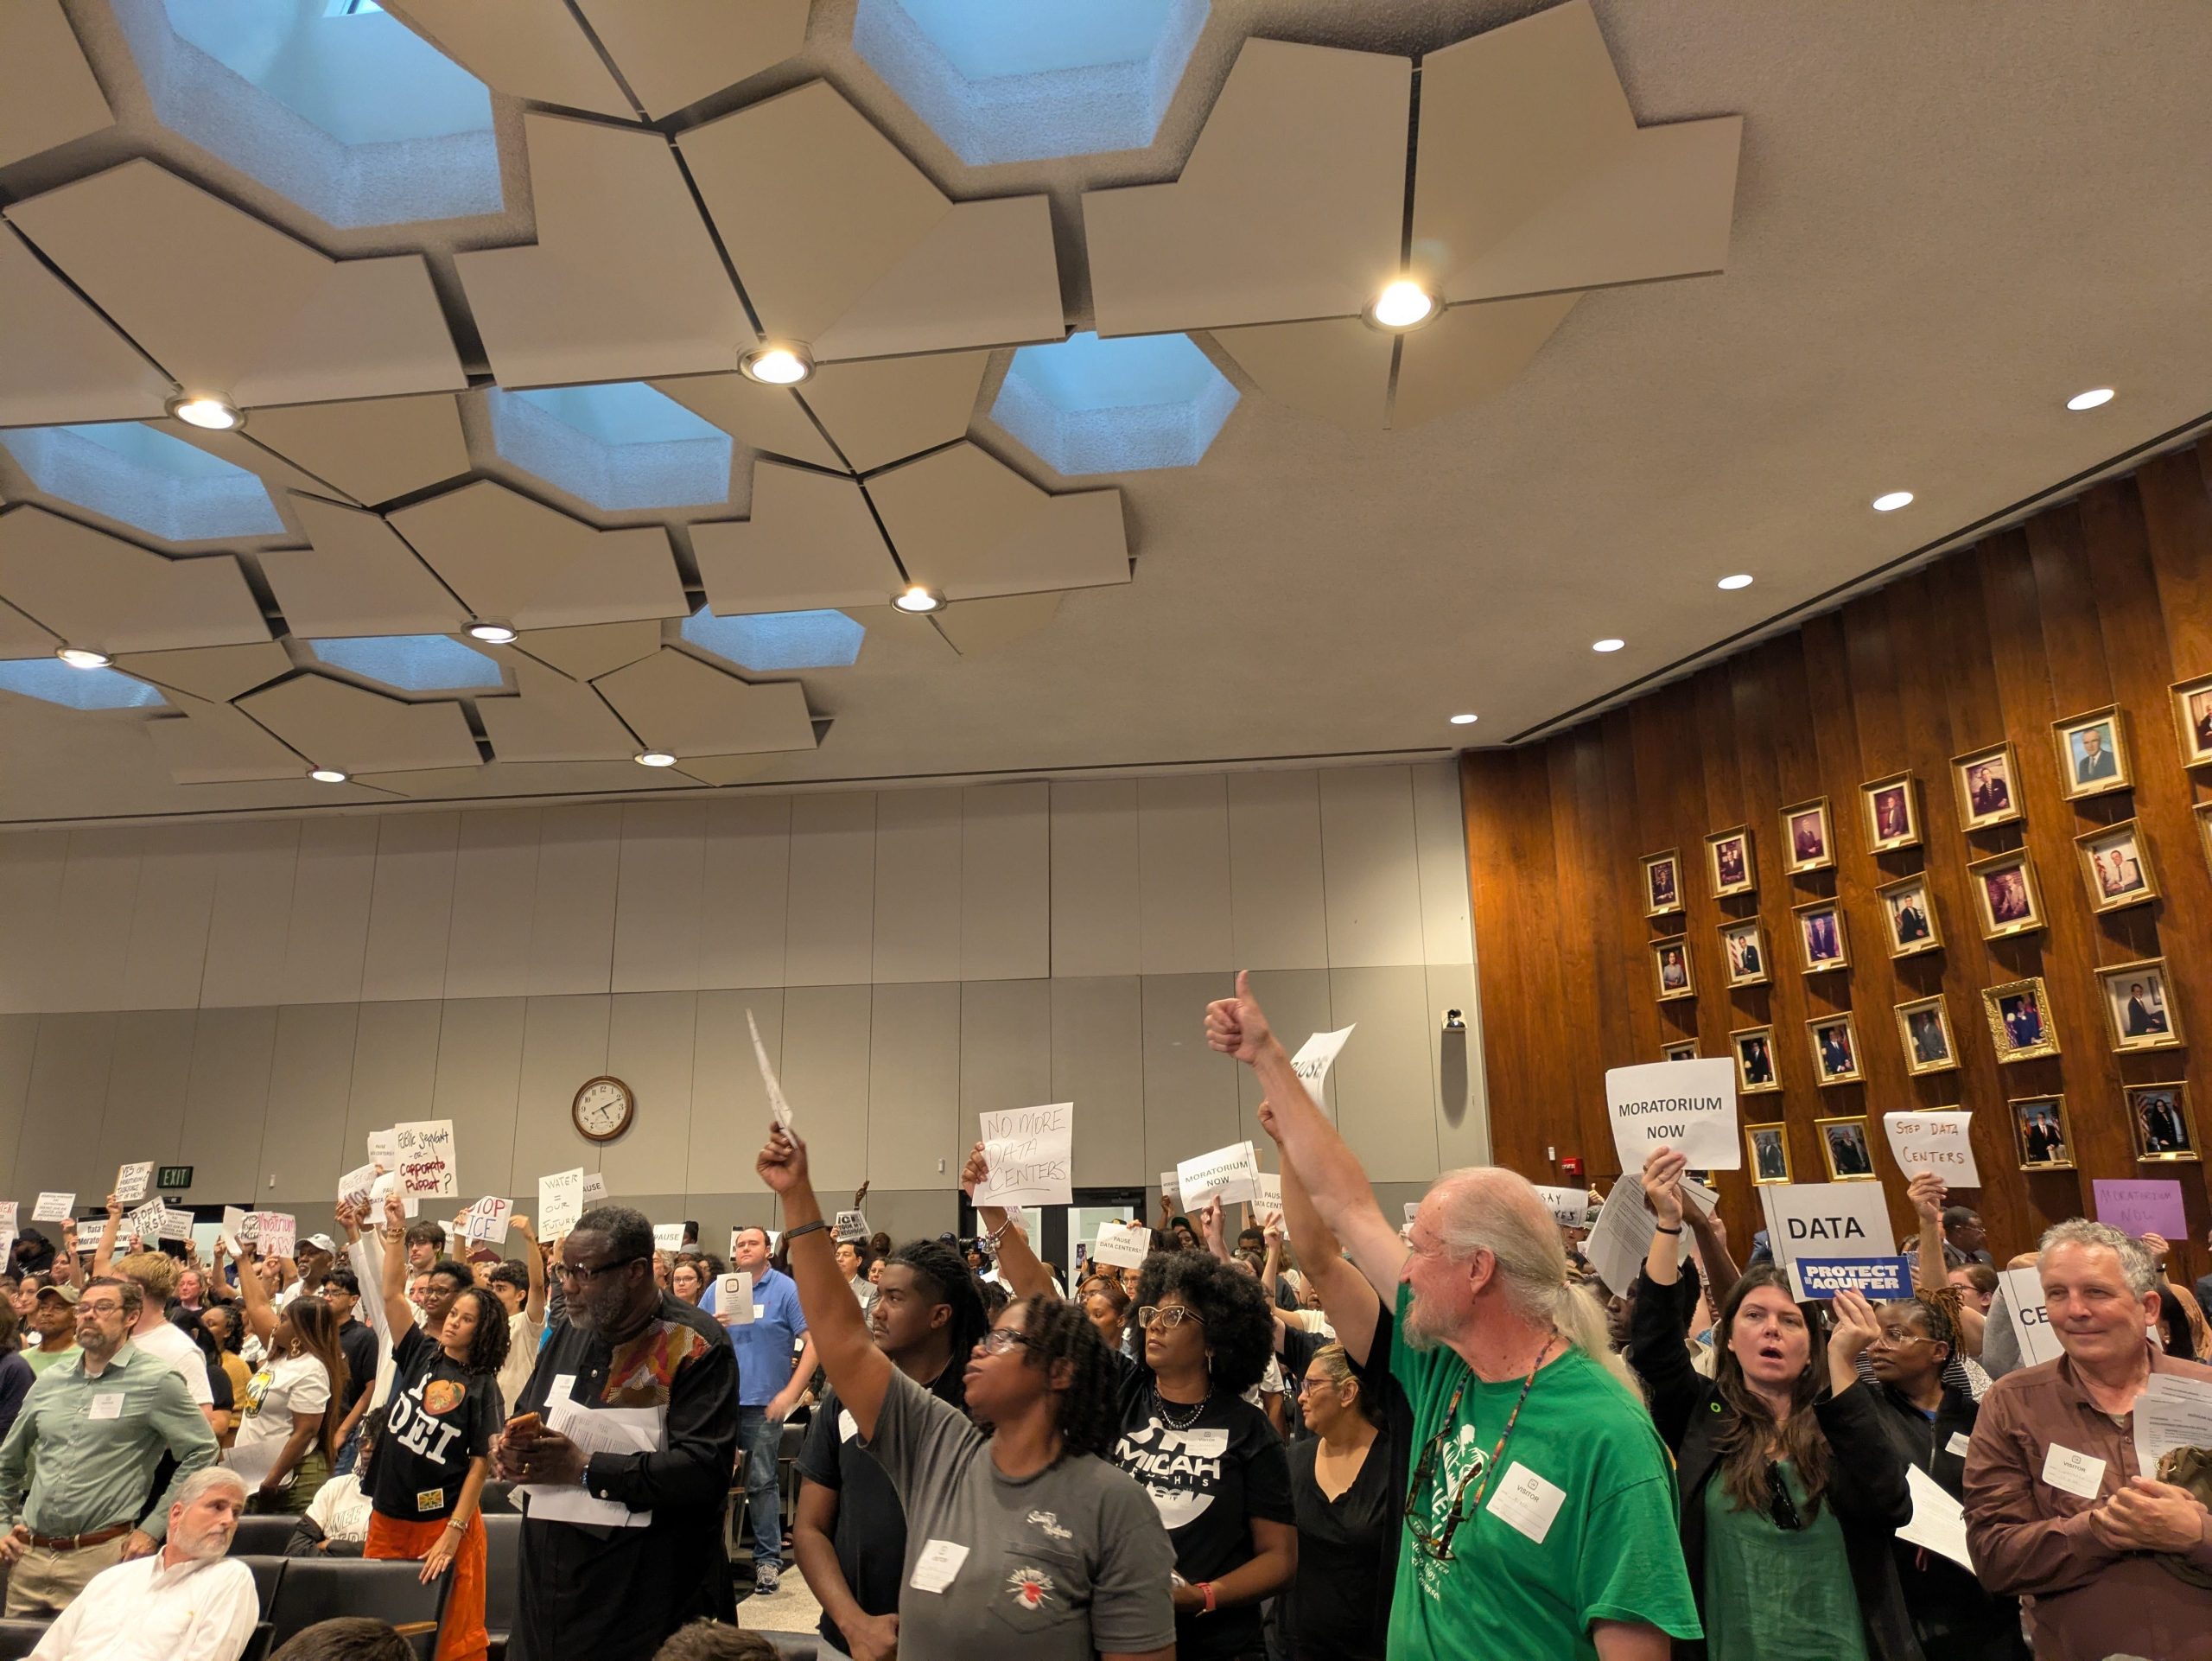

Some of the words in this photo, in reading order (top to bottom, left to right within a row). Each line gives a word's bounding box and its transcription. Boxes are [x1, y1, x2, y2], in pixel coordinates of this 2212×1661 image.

[1618, 1097, 1722, 1117] MORATORIUM
[988, 1112, 1013, 1140] NO
[1020, 1108, 1066, 1137] MORE
[1647, 1124, 1686, 1140] NOW
[1896, 1121, 1920, 1135] STOP
[1930, 1123, 1959, 1136] DATA
[986, 1137, 1038, 1172] DATA
[1903, 1146, 1965, 1165] CENTERS
[163, 1168, 187, 1186] EXIT
[989, 1161, 1066, 1192] CENTERS
[1185, 1161, 1249, 1183] MORATORIUM
[544, 1174, 578, 1189] WATER
[583, 1182, 601, 1193] AUSE
[1207, 1176, 1230, 1187] NOW
[1541, 1193, 1561, 1205] SAY
[545, 1202, 569, 1213] OUR
[1554, 1210, 1575, 1221] YES
[88, 1225, 101, 1233] Data
[467, 1214, 497, 1239] ICE
[543, 1215, 576, 1231] FUTURE
[1787, 1216, 1866, 1239] DATA
[78, 1237, 99, 1245] Morato
[259, 1234, 295, 1255] NOW
[1805, 1265, 1899, 1277] PROTECT
[1812, 1276, 1900, 1289] AQUIFER
[388, 1391, 461, 1465] DEI
[1115, 1438, 1221, 1480] MICAH
[2063, 1461, 2086, 1473] VISITOR
[1517, 1485, 1540, 1503] VISITOR
